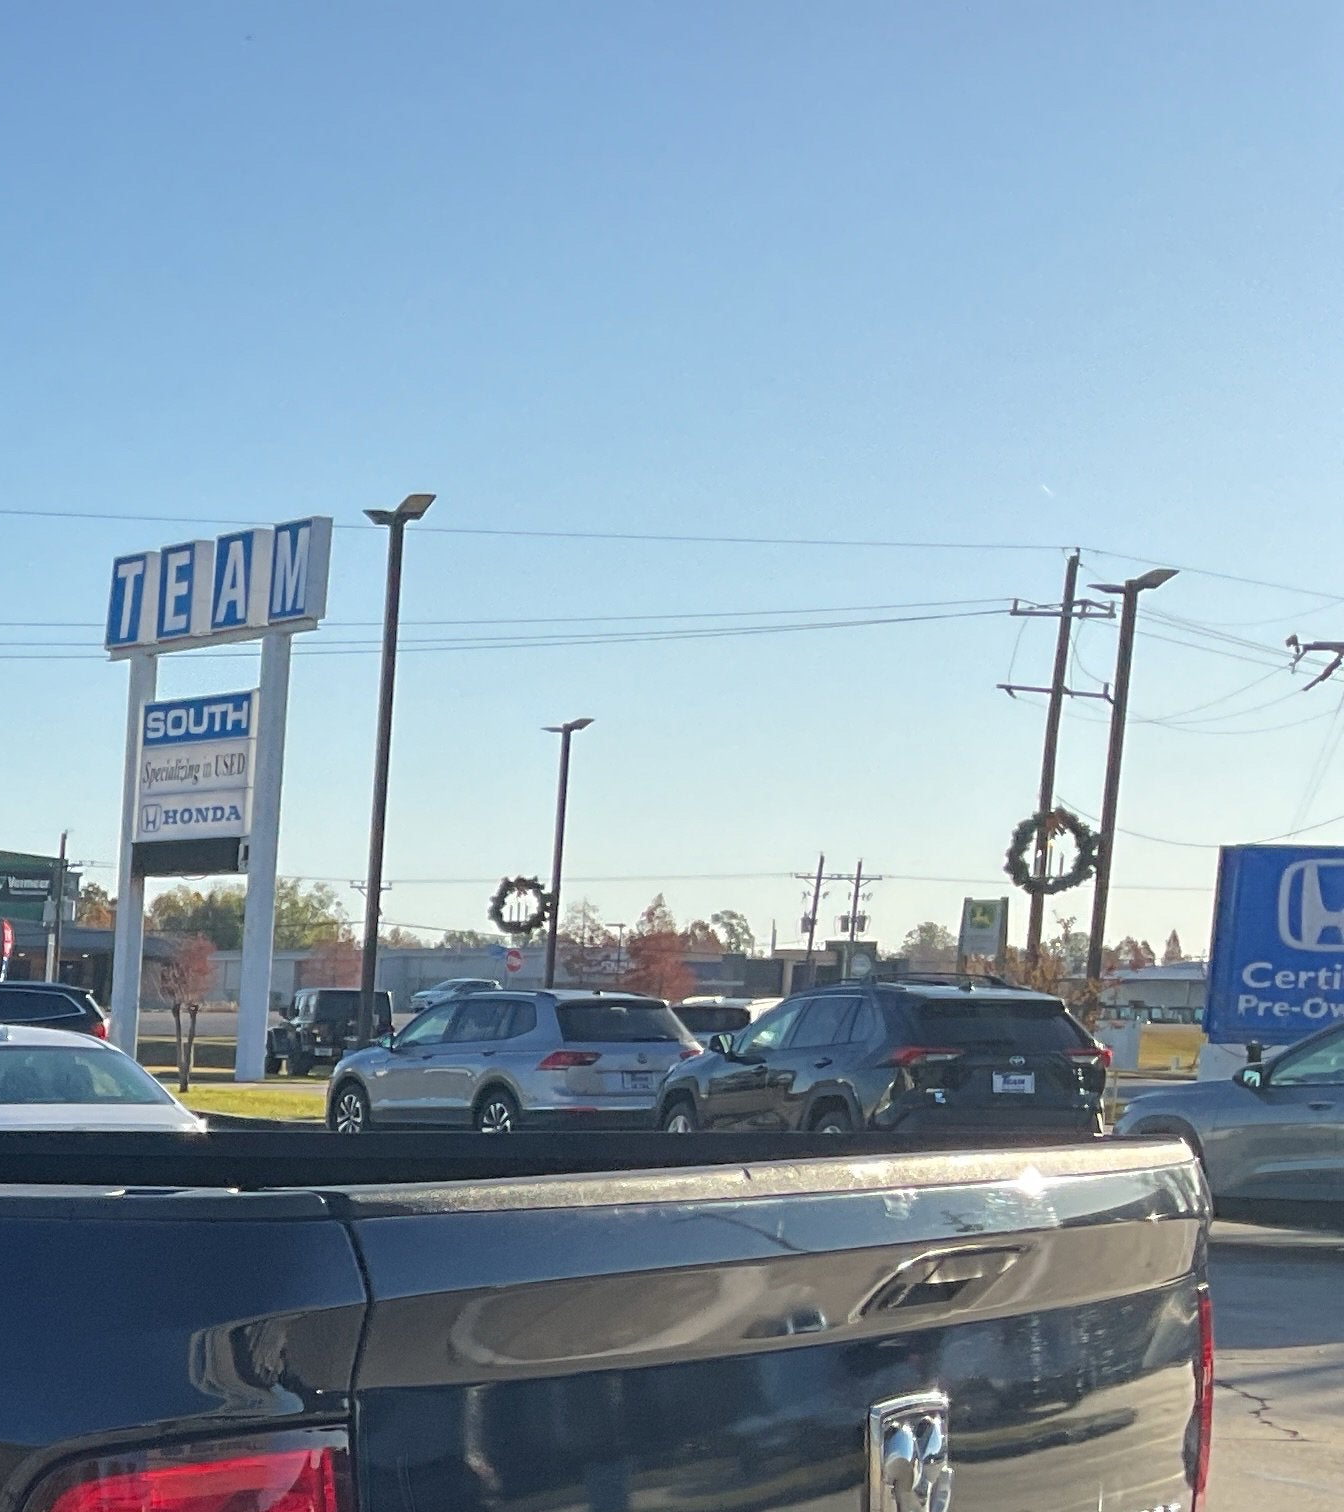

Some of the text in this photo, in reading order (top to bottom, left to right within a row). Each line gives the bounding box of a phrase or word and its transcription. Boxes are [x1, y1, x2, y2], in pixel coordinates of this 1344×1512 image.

[117, 526, 312, 640] TEAM
[146, 701, 249, 739] SOUTH
[143, 753, 246, 789] Specializing in USED
[162, 805, 242, 826] HONDA
